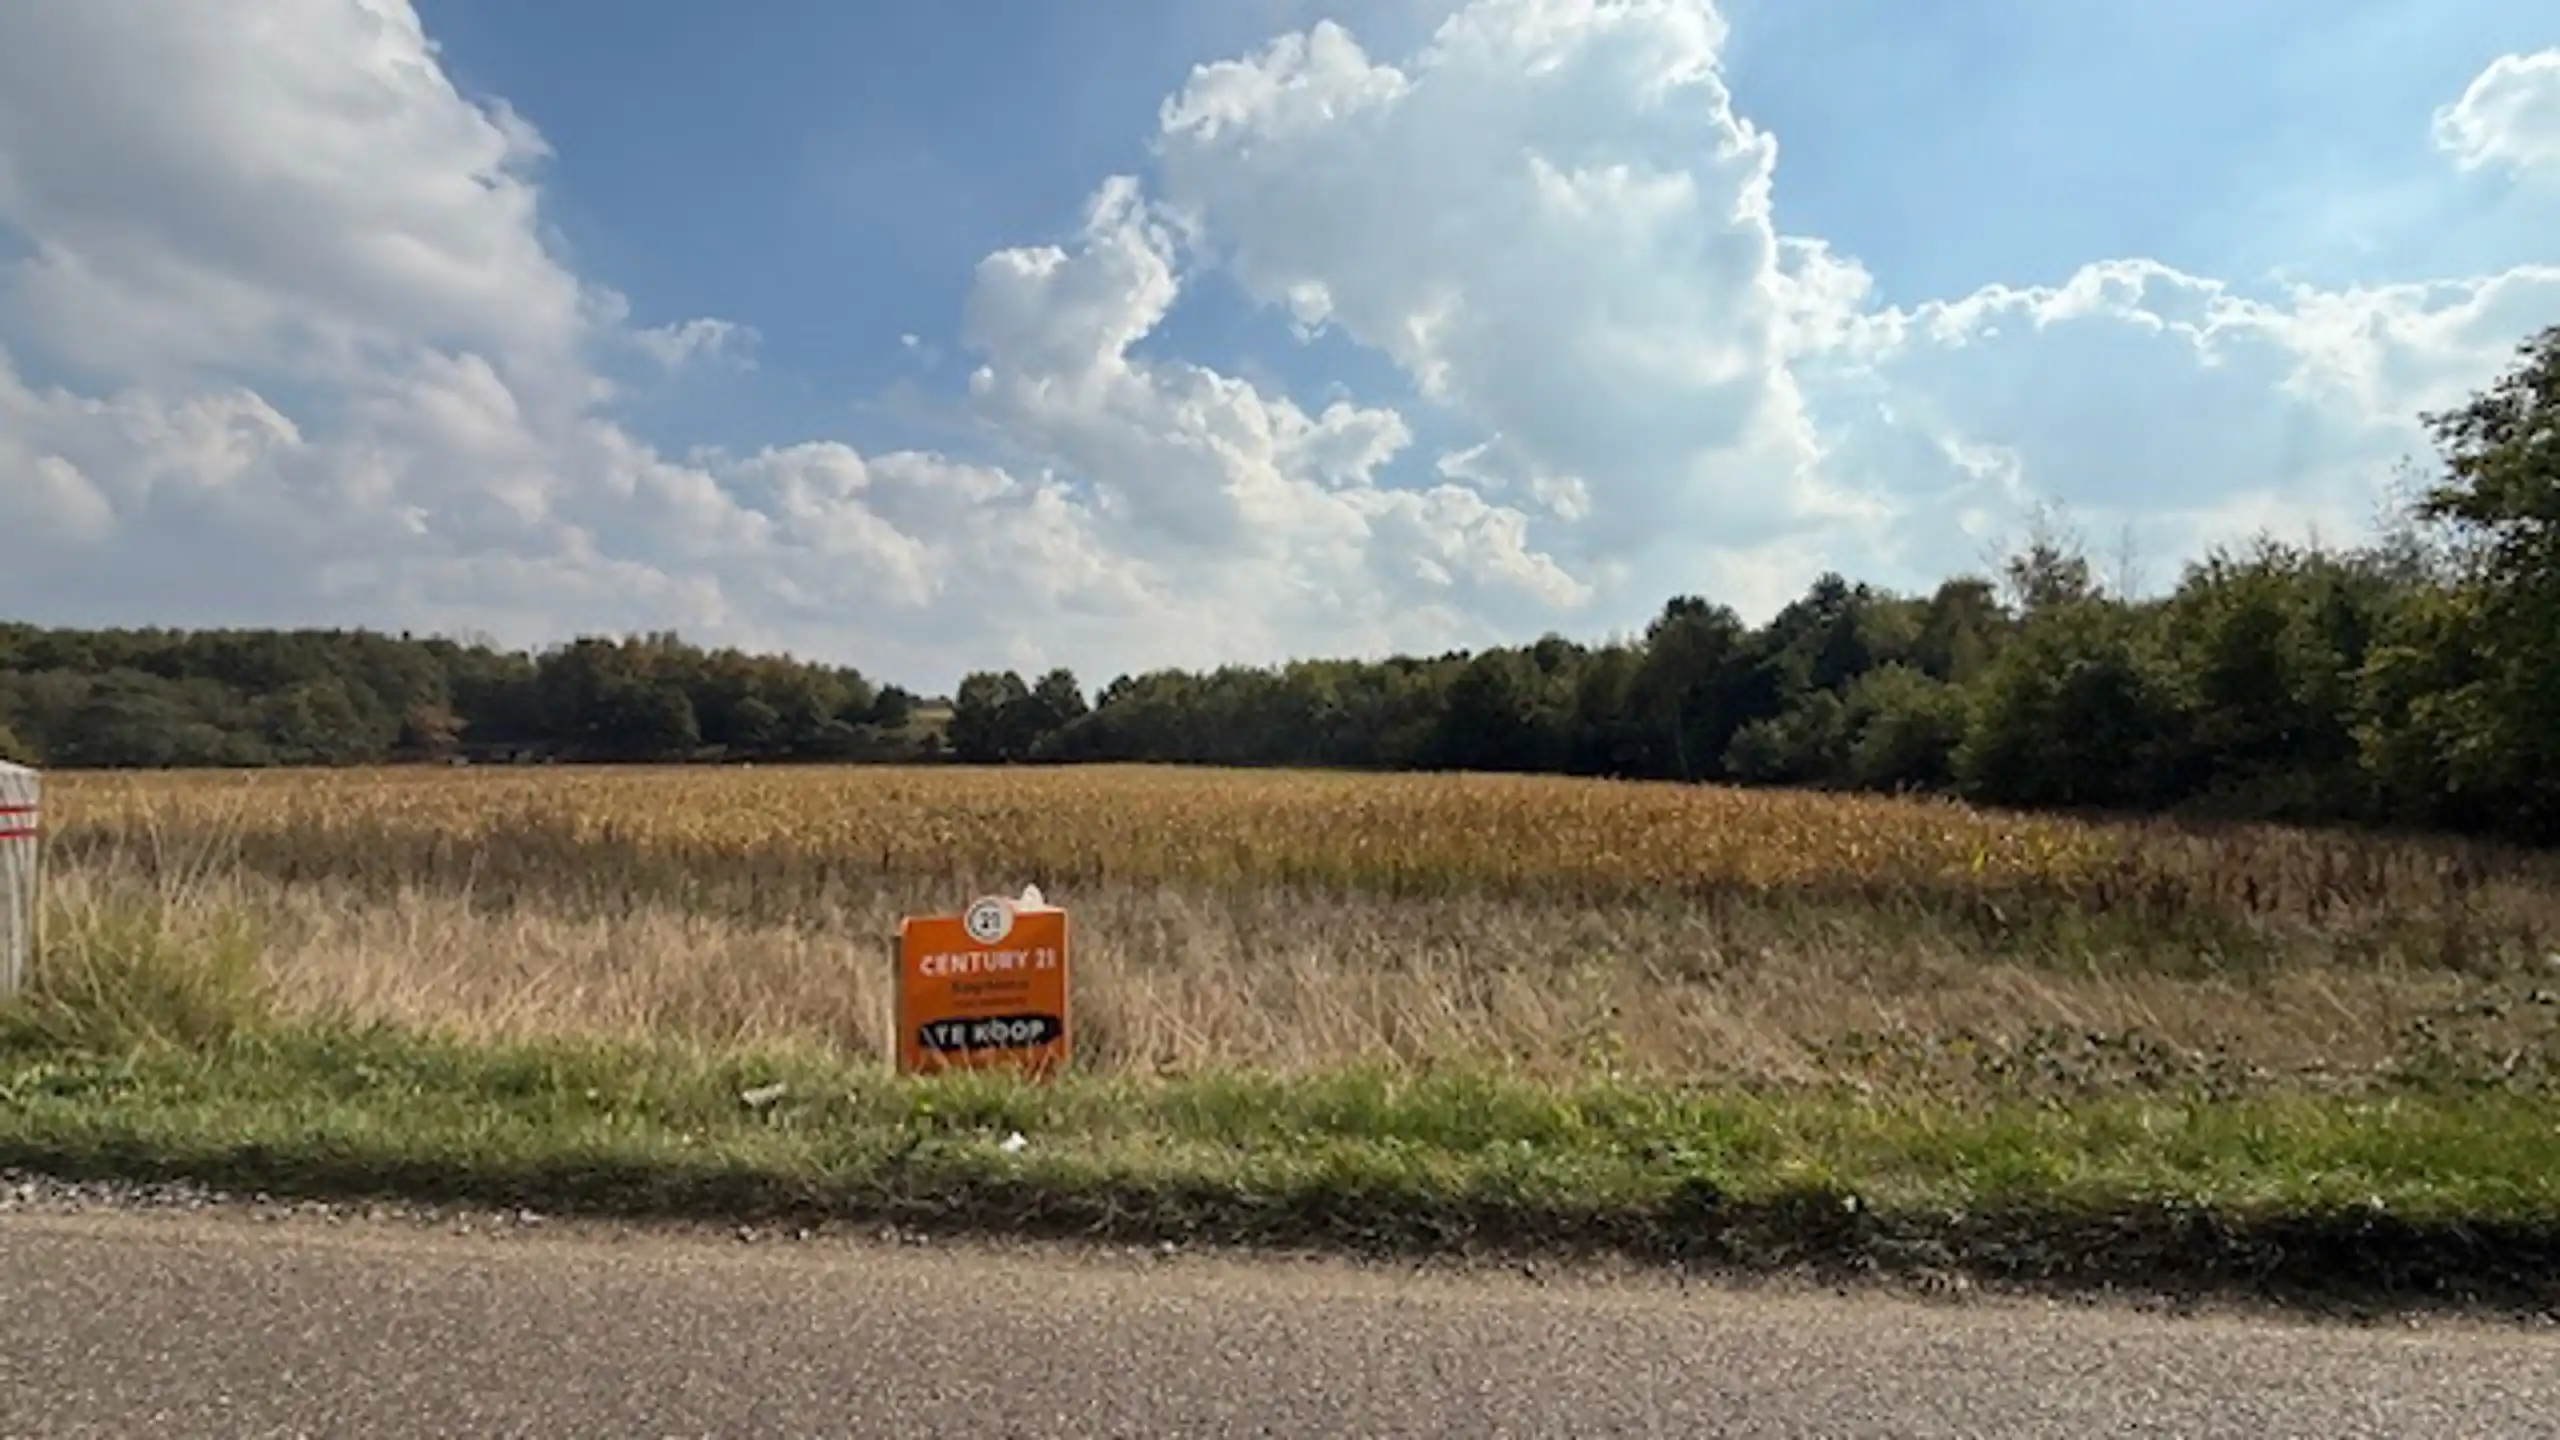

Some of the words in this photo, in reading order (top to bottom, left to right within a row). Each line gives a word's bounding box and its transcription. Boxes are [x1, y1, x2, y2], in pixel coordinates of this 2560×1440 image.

[919, 951, 1028, 976] CENTURY
[1035, 947, 1057, 969] 21
[934, 1023, 965, 1045] TE
[972, 1019, 1045, 1043] KOOP
